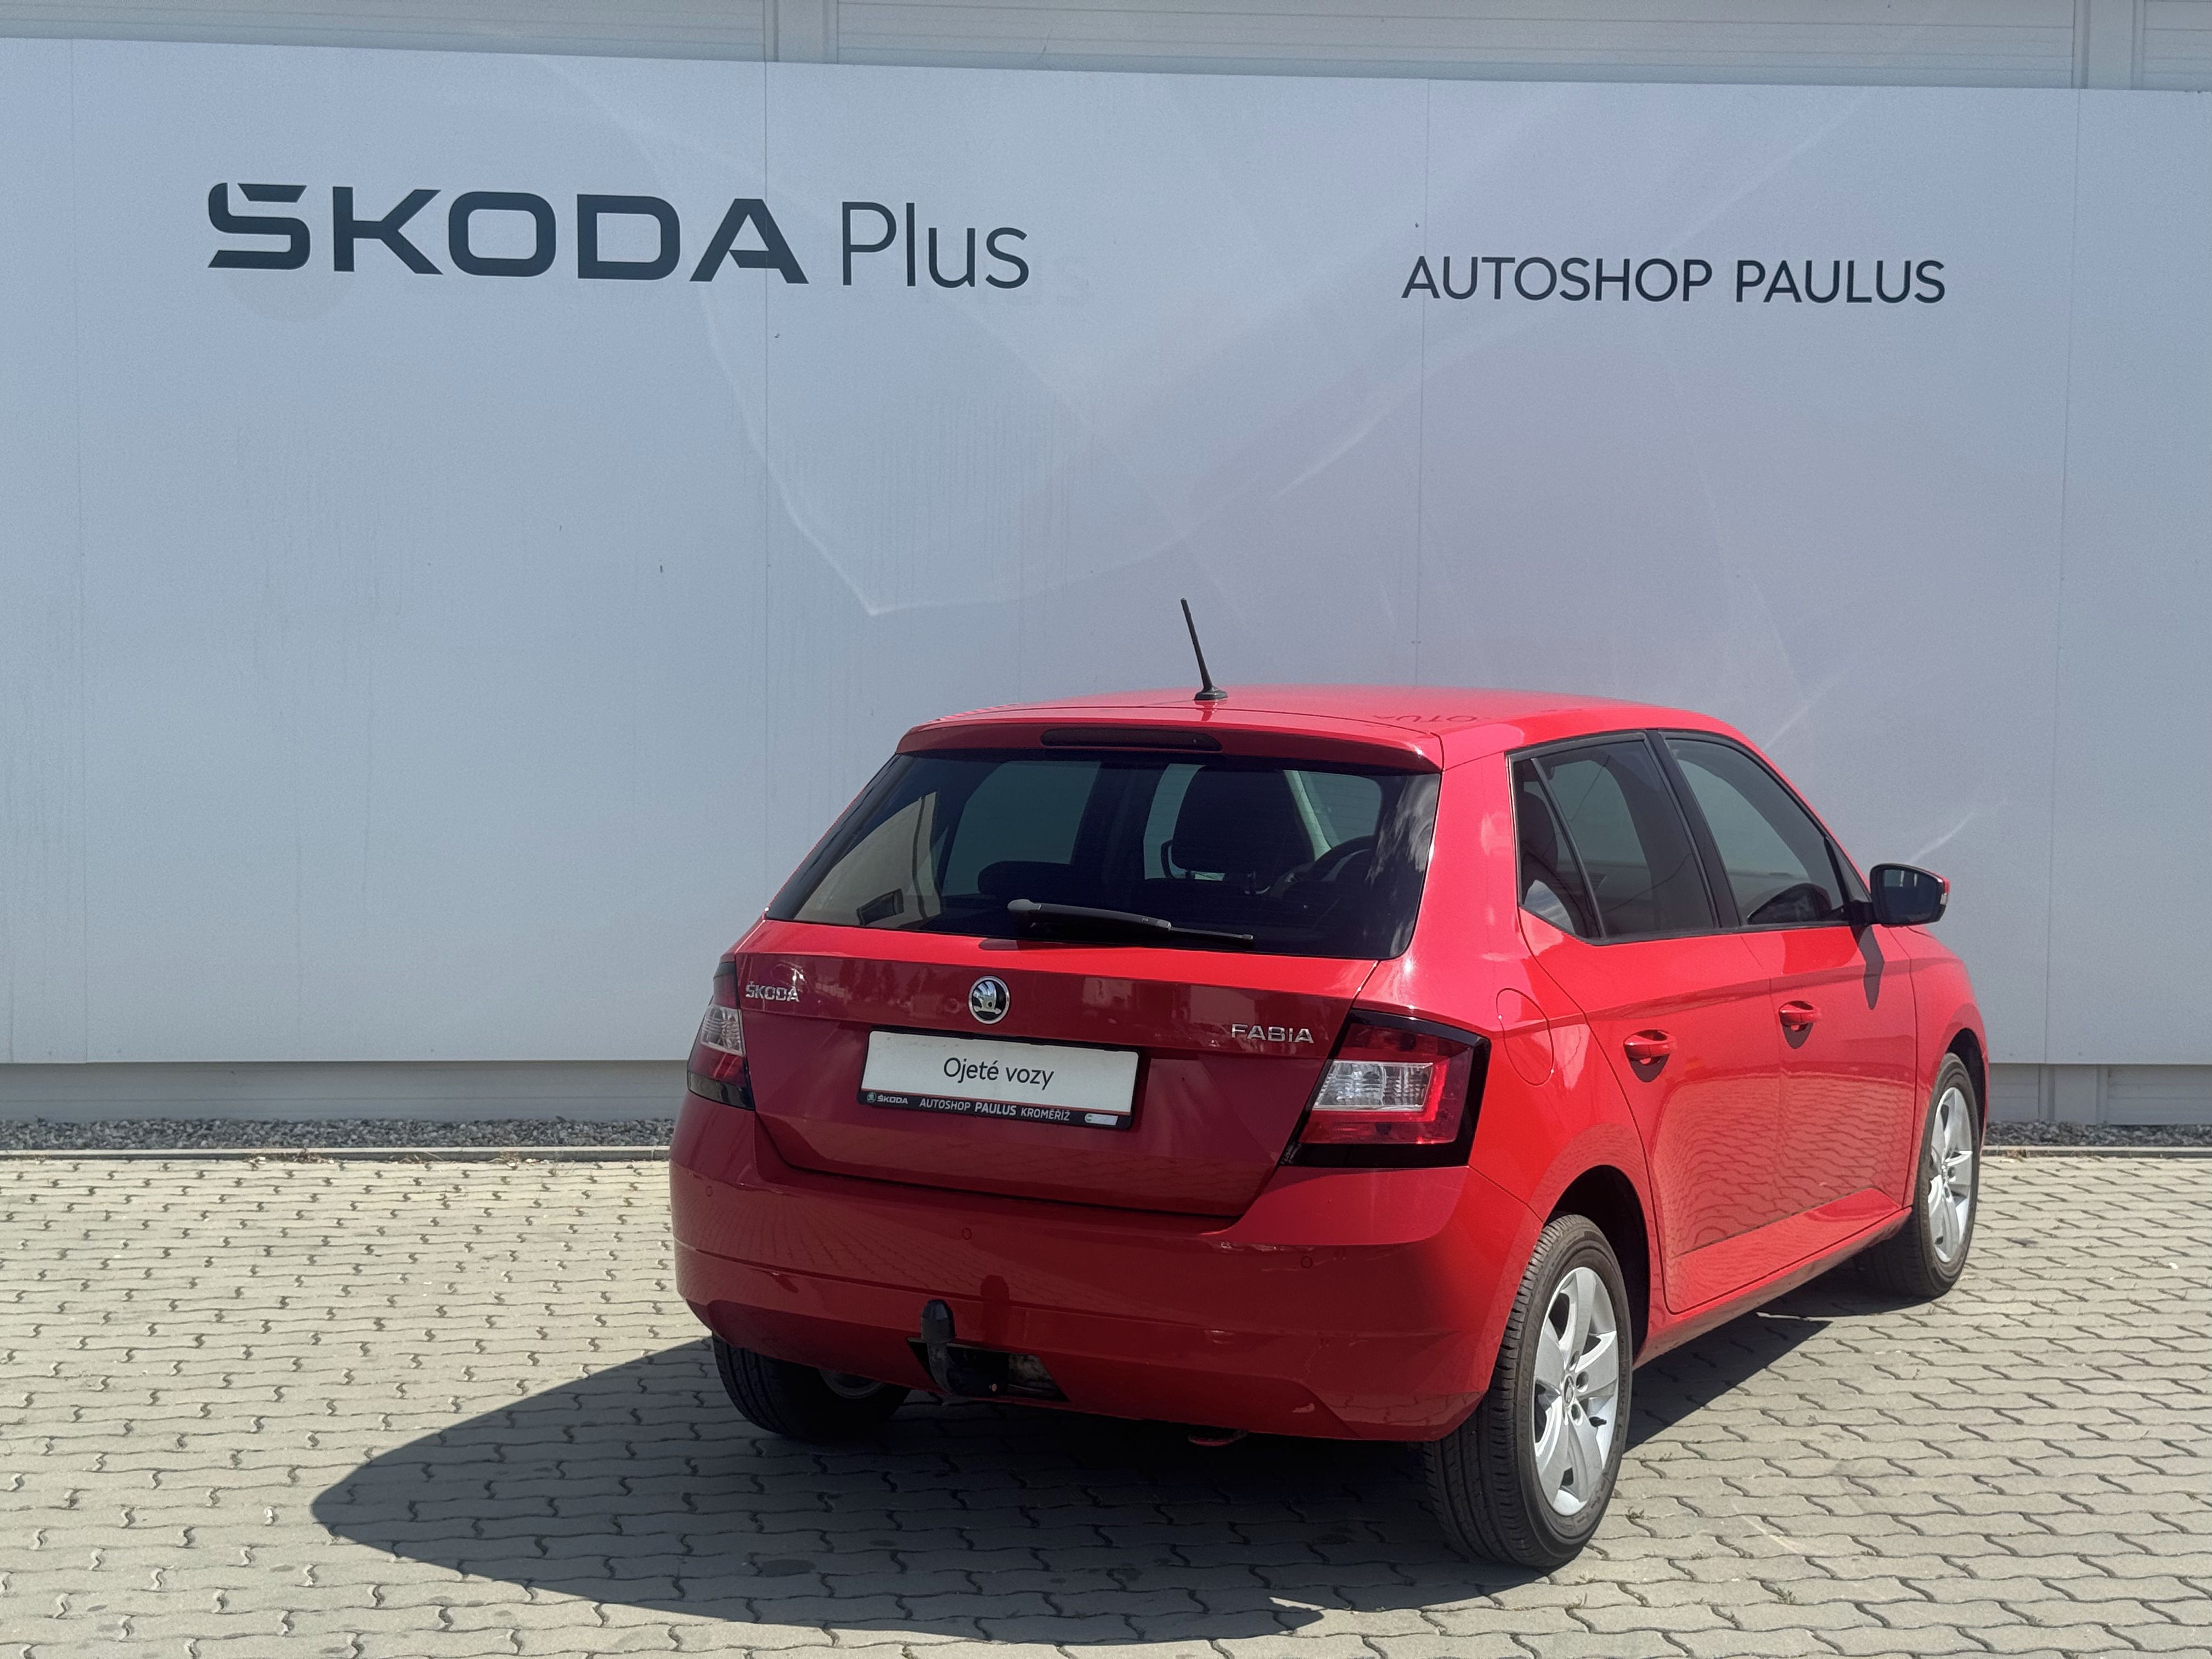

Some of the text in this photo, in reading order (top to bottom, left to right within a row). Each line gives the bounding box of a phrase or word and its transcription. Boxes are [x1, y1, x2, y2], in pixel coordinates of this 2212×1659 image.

[841, 201, 1030, 289] Plus
[1402, 256, 1945, 303] AUTOSHOP PAULUS
[1231, 1023, 1314, 1043] FABIA
[943, 1057, 1055, 1091] Ojeté vozy
[919, 1098, 971, 1111] AUTOSHOP
[974, 1102, 1017, 1116] PAULUS
